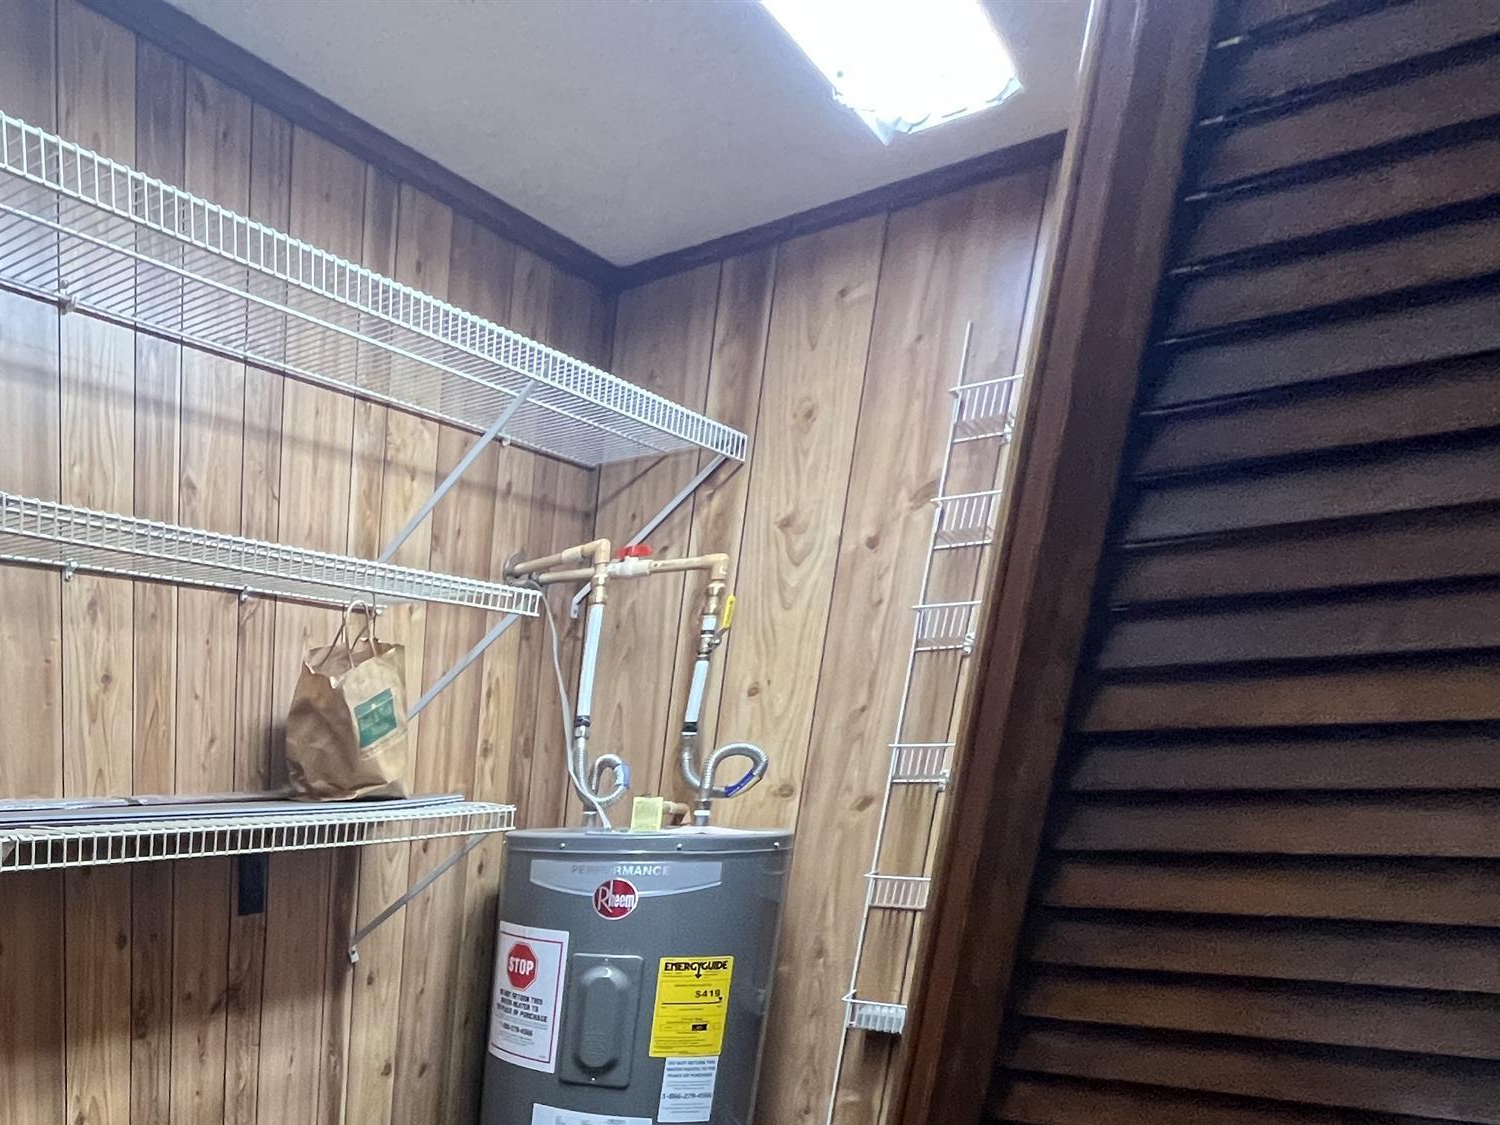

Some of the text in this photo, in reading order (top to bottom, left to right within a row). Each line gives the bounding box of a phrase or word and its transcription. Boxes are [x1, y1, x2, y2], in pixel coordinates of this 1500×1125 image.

[571, 865, 670, 876] PERMANCE
[597, 879, 635, 913] Rheem
[508, 956, 534, 976] STOP
